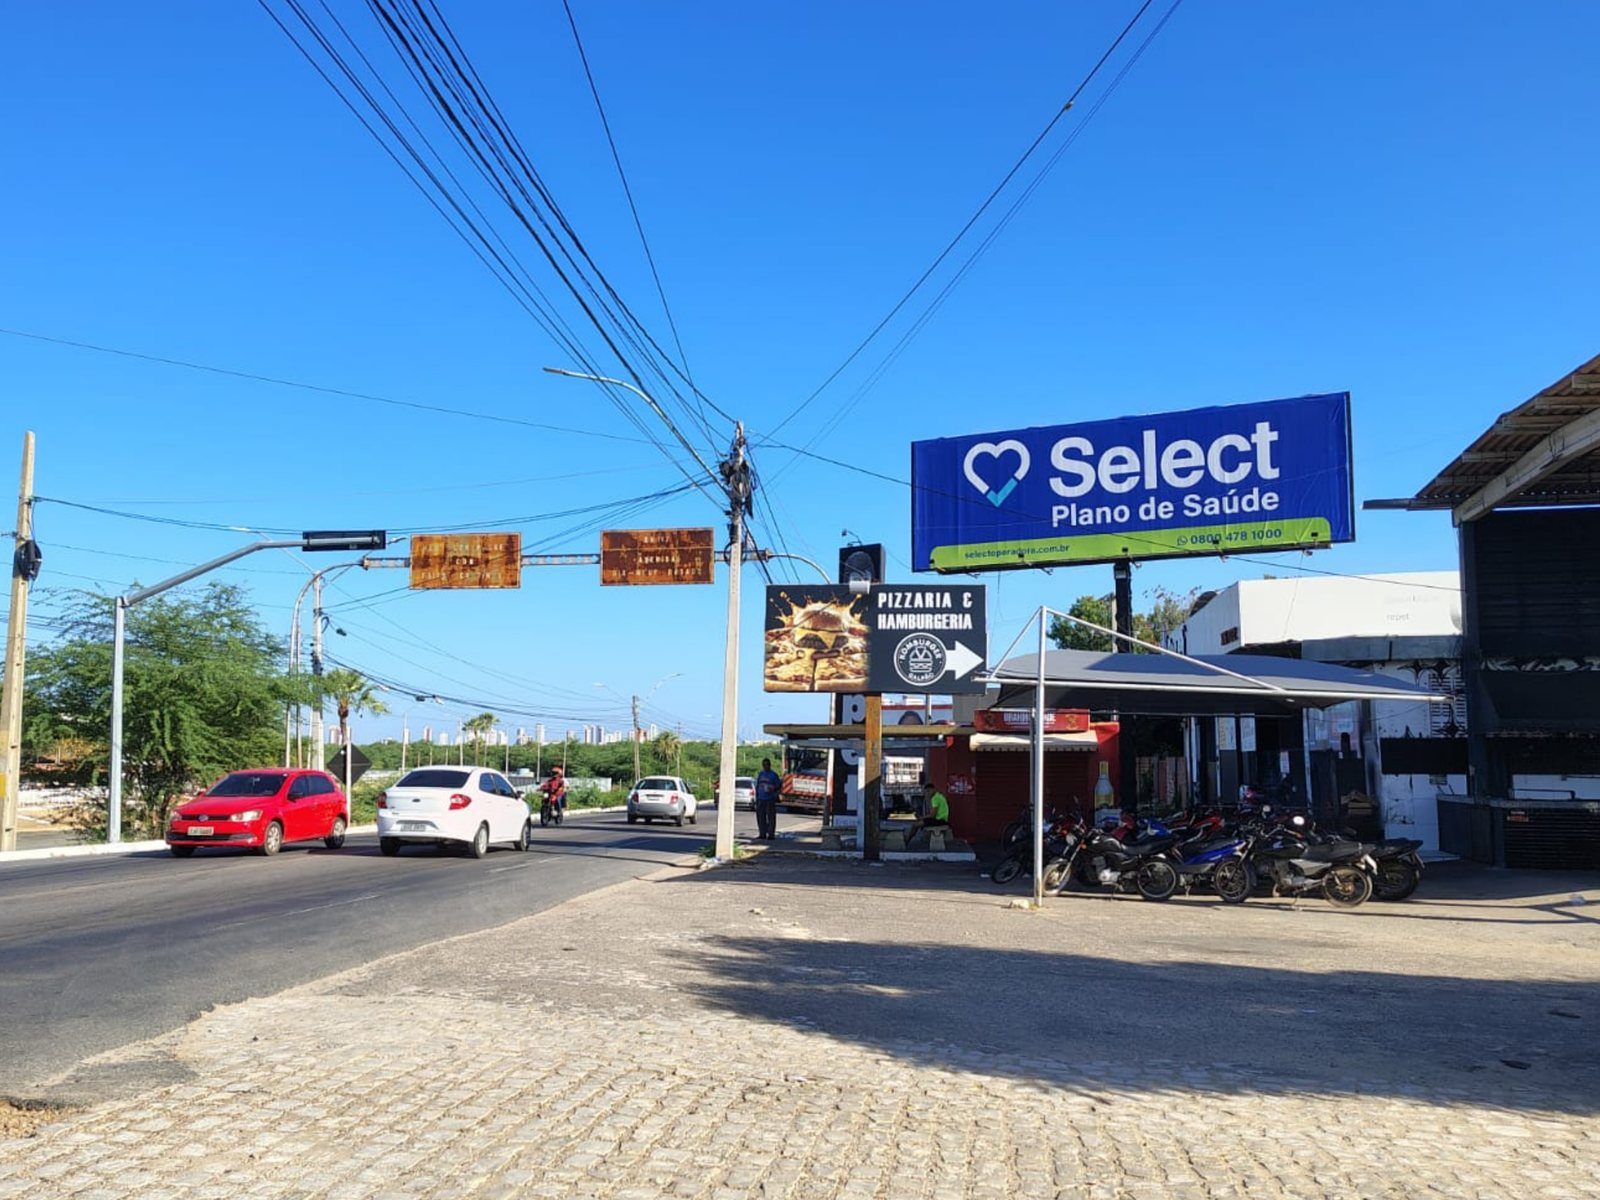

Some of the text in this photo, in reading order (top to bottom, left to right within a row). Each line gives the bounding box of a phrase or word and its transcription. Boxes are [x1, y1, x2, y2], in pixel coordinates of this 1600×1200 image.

[1049, 421, 1280, 498] Select
[1052, 486, 1280, 528] Plano de Saúde
[1190, 528, 1283, 545] 0800 478 1000
[877, 591, 953, 609] PIZZARIA
[877, 612, 974, 631] HAMBURGERIA
